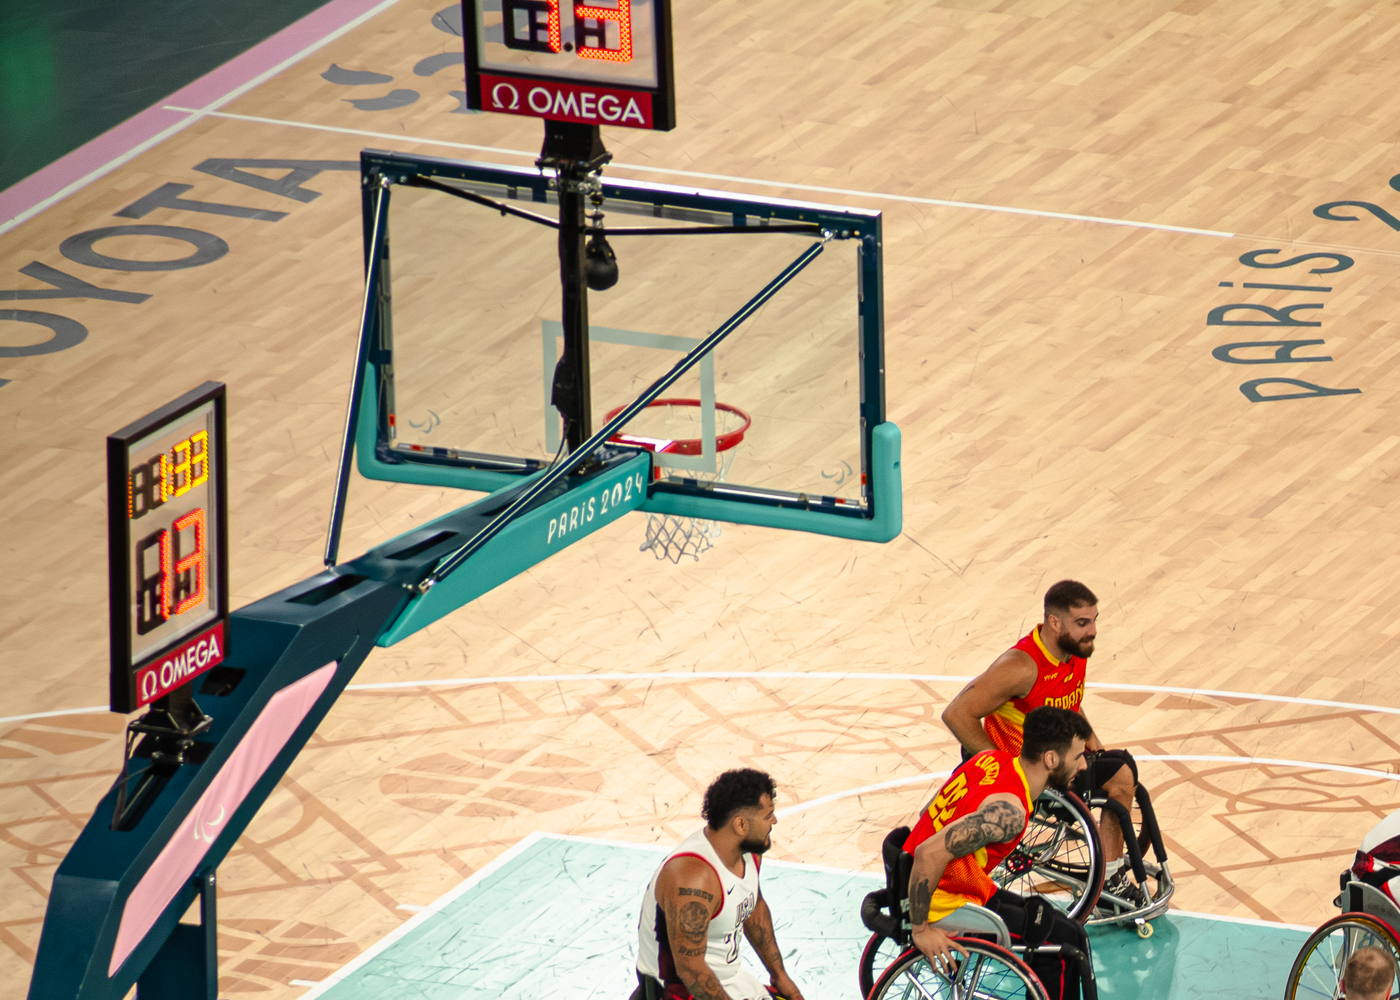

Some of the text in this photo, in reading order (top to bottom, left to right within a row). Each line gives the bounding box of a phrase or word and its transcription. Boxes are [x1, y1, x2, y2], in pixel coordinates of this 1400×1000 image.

[527, 86, 646, 125] OMEGA
[600, 472, 643, 515] 2024
[160, 507, 206, 621] 13
[160, 634, 221, 689] OMEGA
